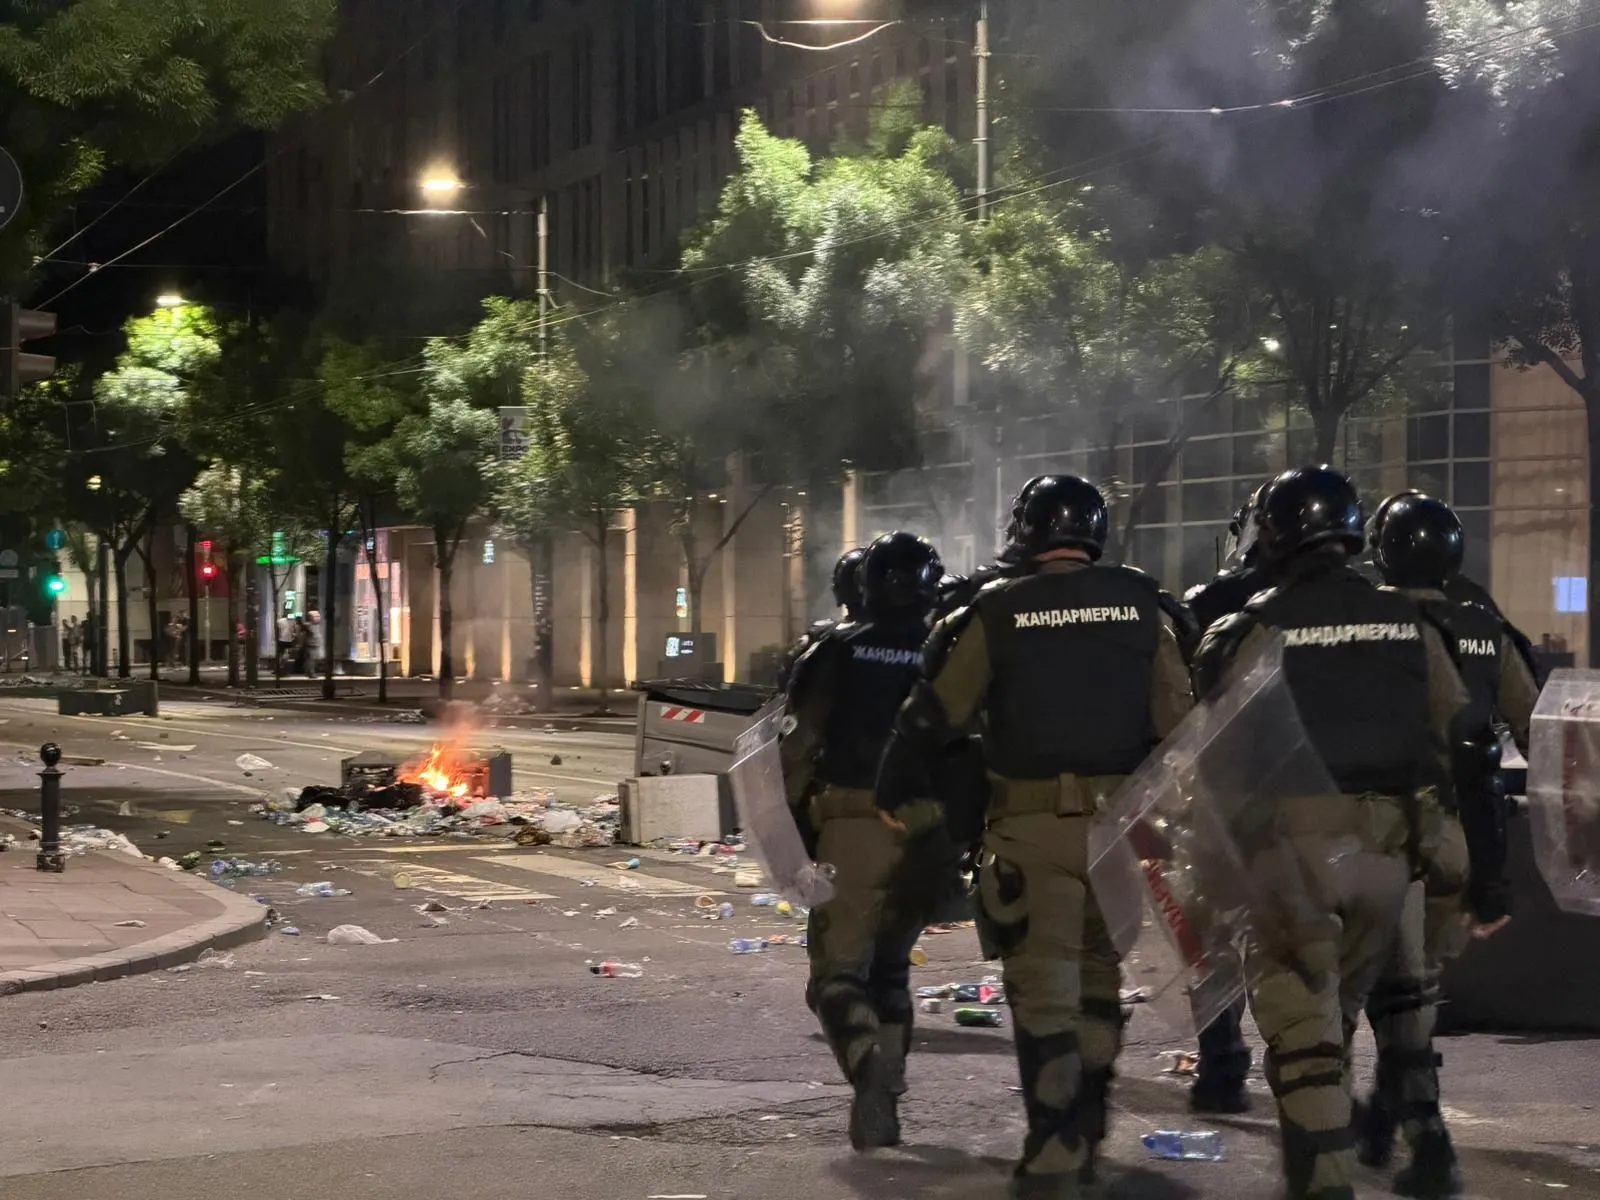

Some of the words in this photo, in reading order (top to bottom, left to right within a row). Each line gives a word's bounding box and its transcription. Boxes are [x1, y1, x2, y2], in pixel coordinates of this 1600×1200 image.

[1014, 606, 1140, 628] ЖАНДАРМЕРИЈА
[1281, 623, 1420, 647] ЖАНДАРМЕРИЈА
[1459, 638, 1496, 656] РИЈА
